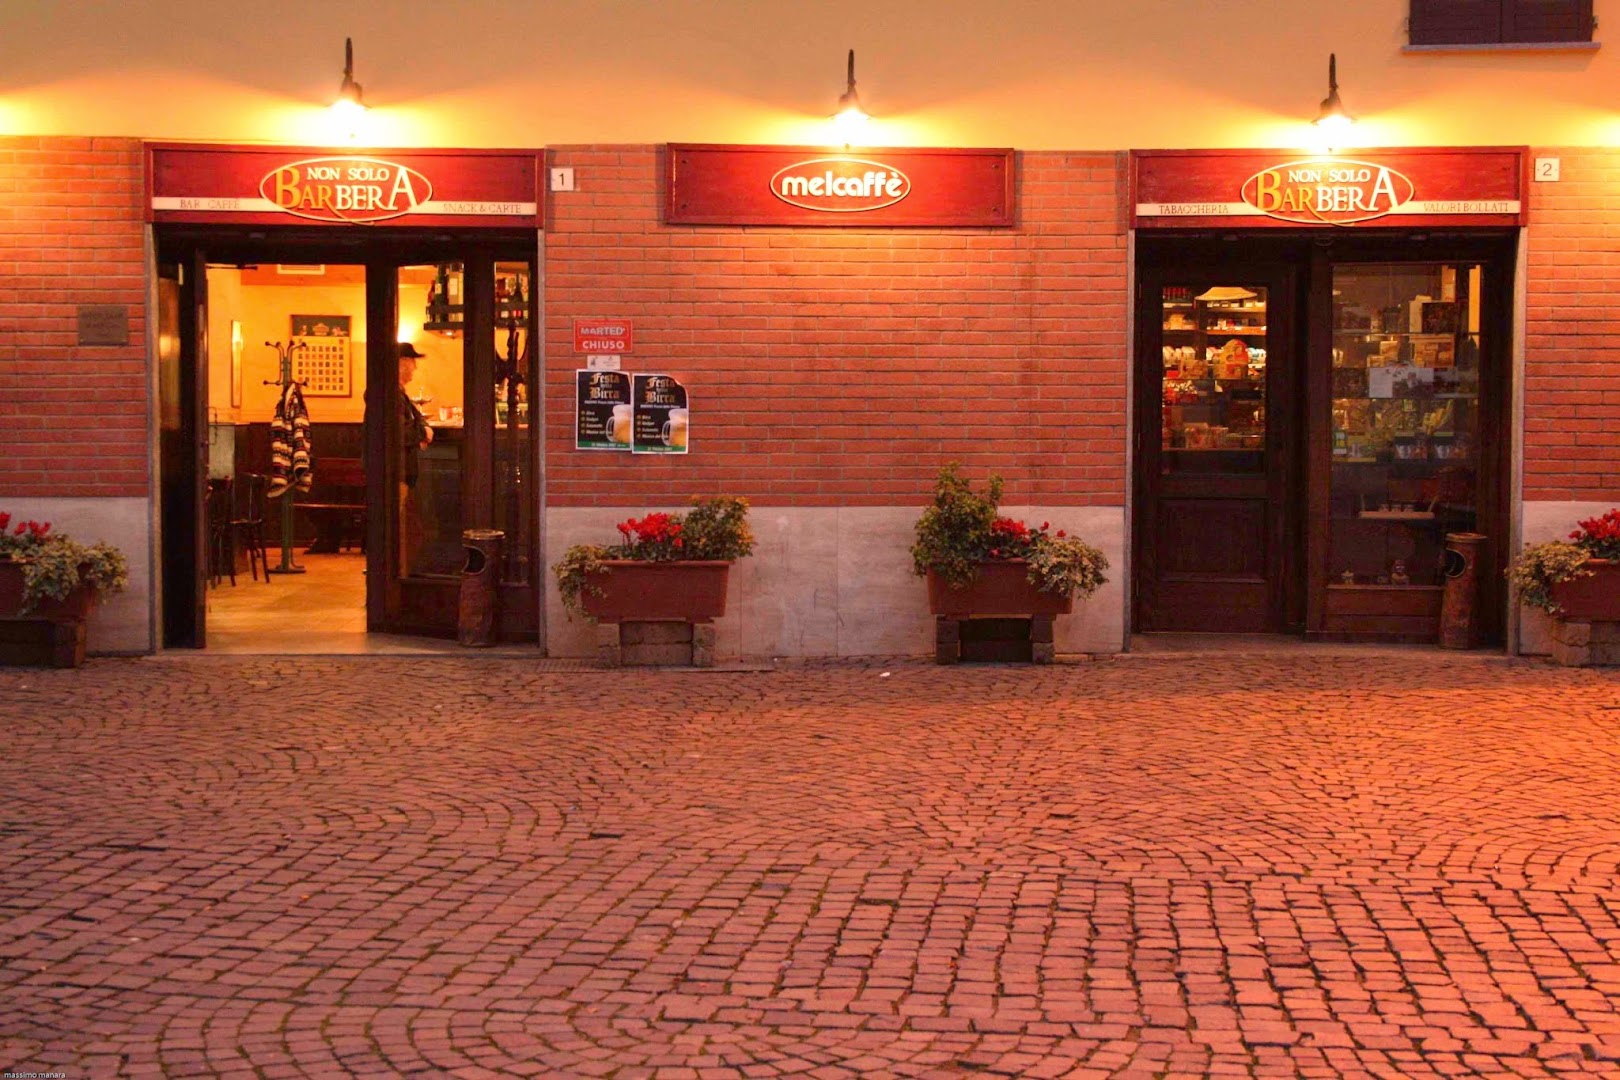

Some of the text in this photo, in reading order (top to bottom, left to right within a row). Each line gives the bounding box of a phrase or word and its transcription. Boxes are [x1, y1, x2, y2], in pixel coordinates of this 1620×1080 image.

[307, 166, 390, 182] NON SOLO
[1288, 168, 1371, 183] NON SOLO
[1542, 162, 1553, 177] 2
[559, 173, 565, 186] 1
[781, 170, 903, 198] melcaffè
[180, 199, 201, 209] BAR
[443, 203, 522, 214] SNACK & CARTE
[1158, 204, 1230, 215] TABACCHERIA
[1423, 202, 1509, 213] VALORI BOLLATI
[582, 340, 625, 350] CHIUSO
[590, 373, 620, 385] Festa
[590, 387, 620, 399] Birra
[645, 391, 675, 403] Birra
